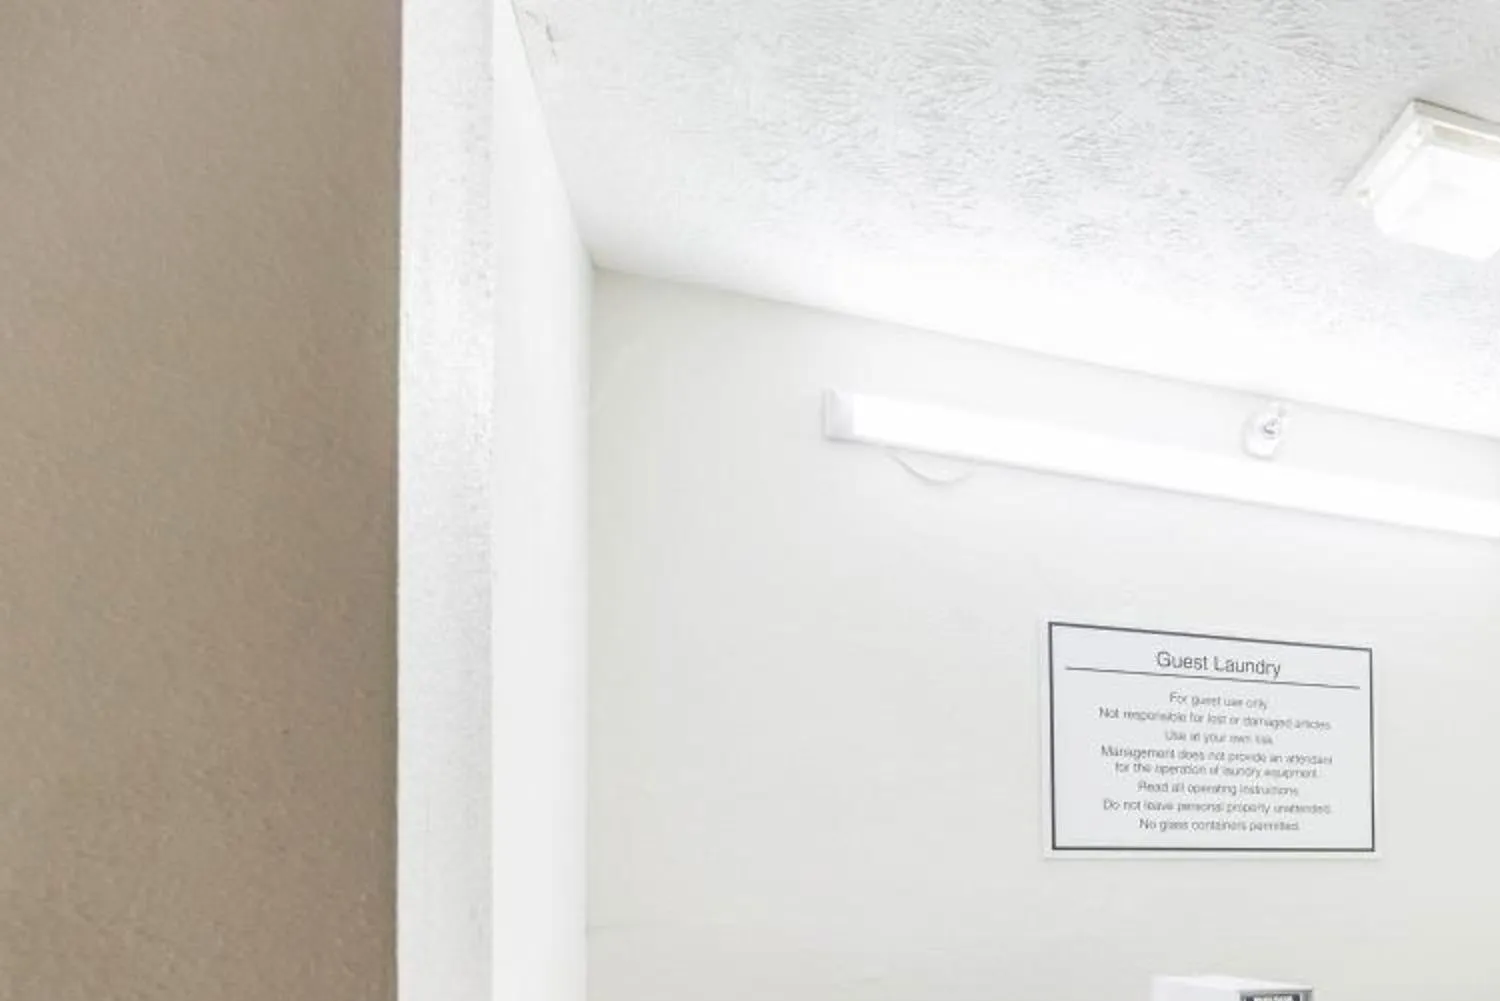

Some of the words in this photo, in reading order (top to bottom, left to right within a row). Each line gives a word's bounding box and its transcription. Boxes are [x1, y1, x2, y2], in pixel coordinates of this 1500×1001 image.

[1156, 651, 1208, 671] Guest
[1213, 656, 1281, 680] Laundry
[1169, 691, 1187, 703] For
[1099, 706, 1119, 719] Not
[1103, 799, 1120, 811] Do
[1139, 819, 1157, 830] No
